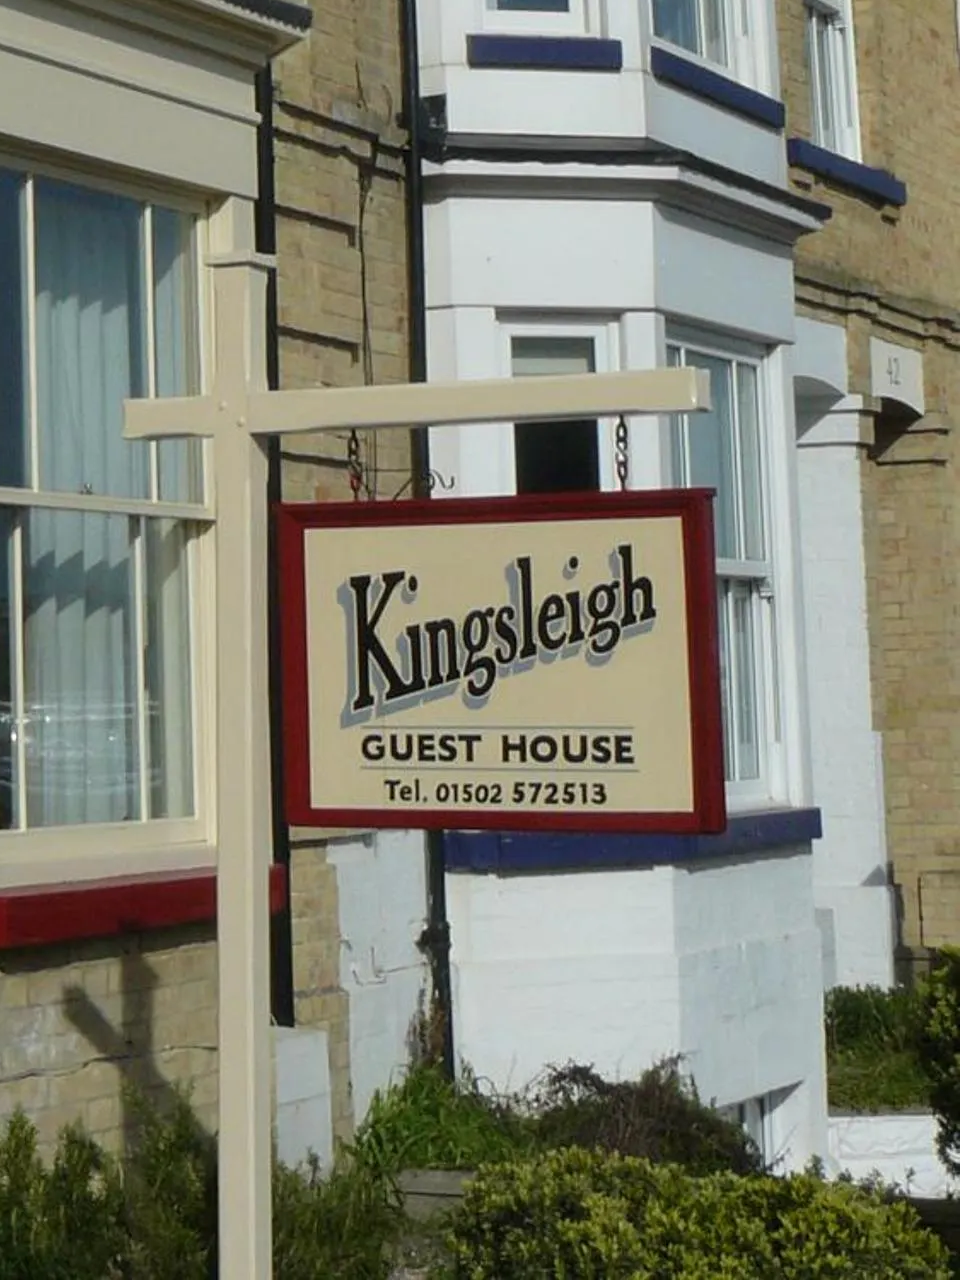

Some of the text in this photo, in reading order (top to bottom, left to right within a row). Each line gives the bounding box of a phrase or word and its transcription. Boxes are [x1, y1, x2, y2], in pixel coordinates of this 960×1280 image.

[886, 357, 901, 386] 42
[349, 544, 657, 711] Kingsleigh
[361, 734, 636, 765] GUEST HOUSE
[384, 779, 608, 806] Tel. 01502 572513
